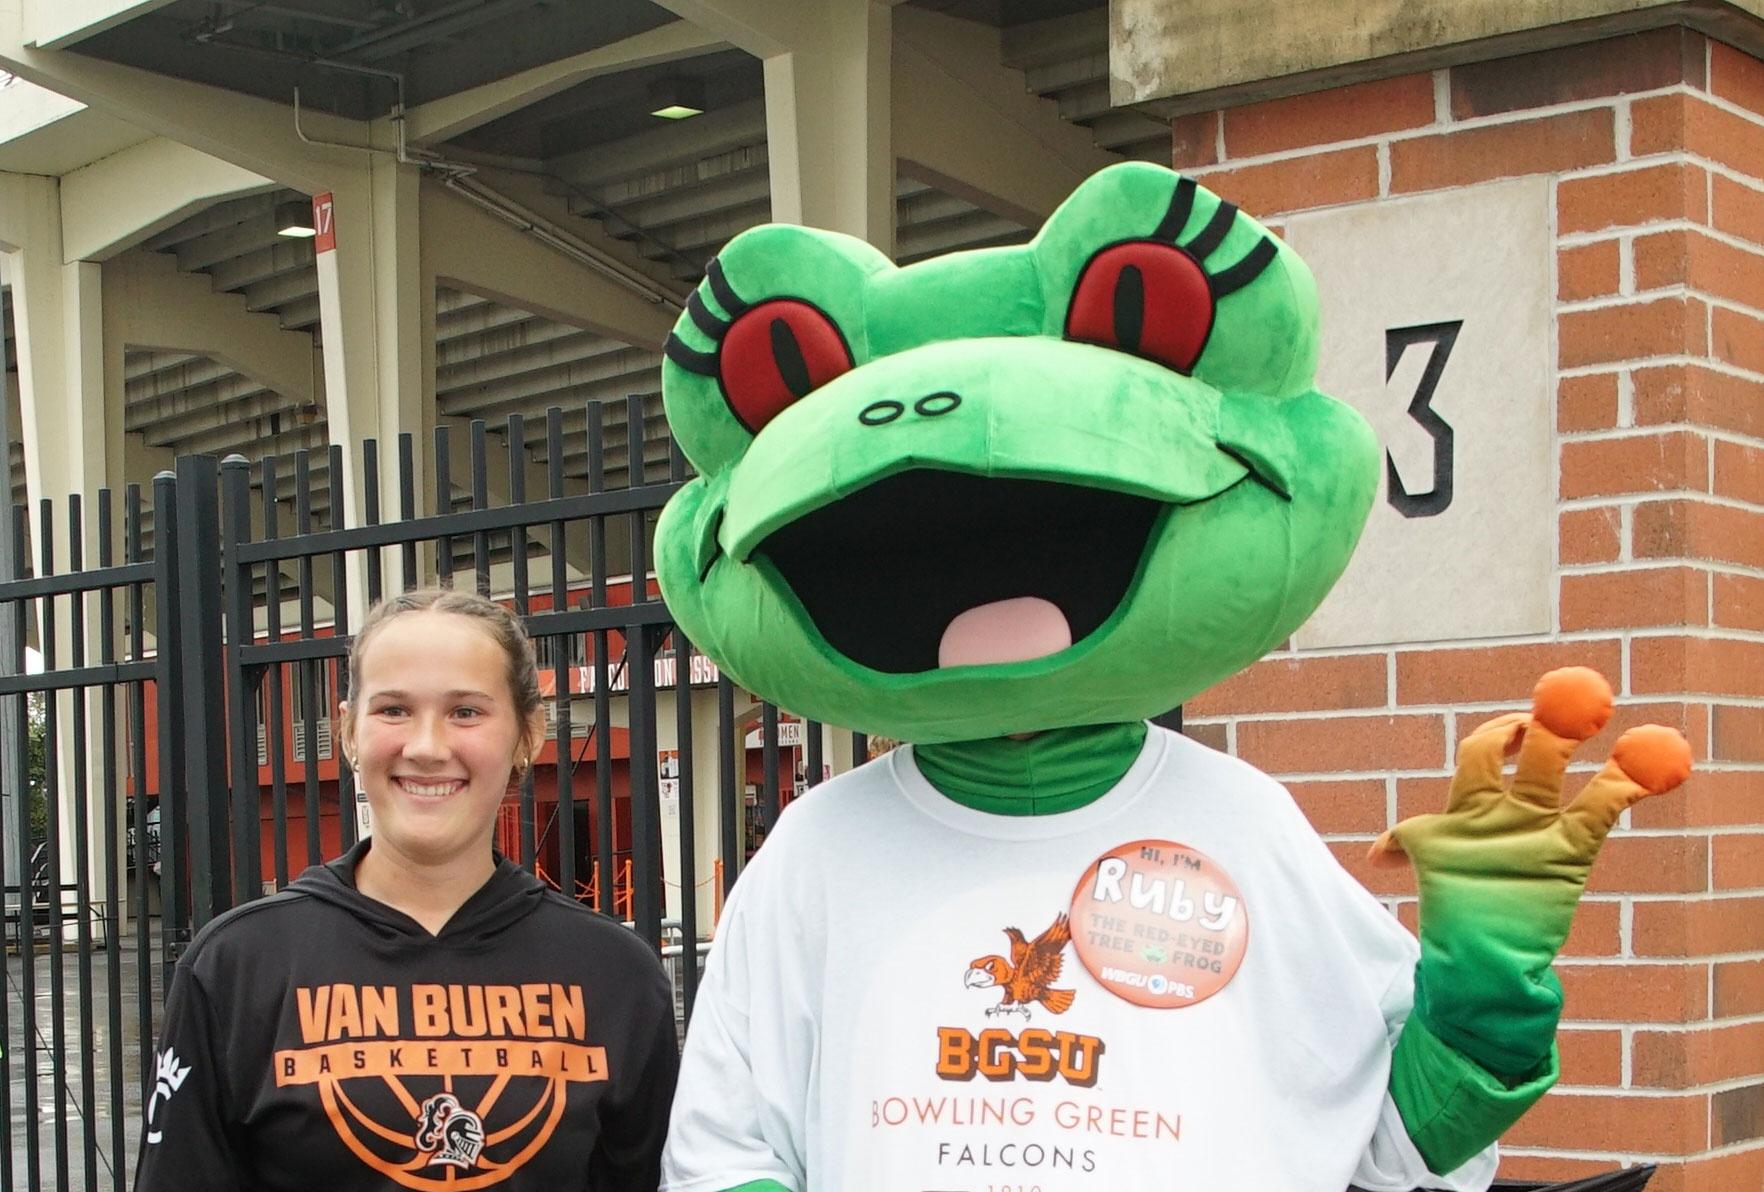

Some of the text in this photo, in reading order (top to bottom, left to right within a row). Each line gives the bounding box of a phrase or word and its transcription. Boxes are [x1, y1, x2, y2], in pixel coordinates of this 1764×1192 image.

[315, 201, 332, 236] 17
[1385, 319, 1464, 519] 3
[1140, 846, 1165, 866] HI,
[1093, 855, 1237, 932] Ruby
[1088, 930, 1223, 974] TREE FROG
[1091, 913, 1225, 956] THE RED-EYED
[1168, 982, 1195, 1000] PBS
[296, 983, 586, 1044] VAN BUREN
[284, 1047, 598, 1078] BASKETBALL
[936, 1026, 1106, 1089] BGSU
[872, 1097, 1182, 1142] BOWLING GREEN
[938, 1143, 1097, 1173] FALCONS
